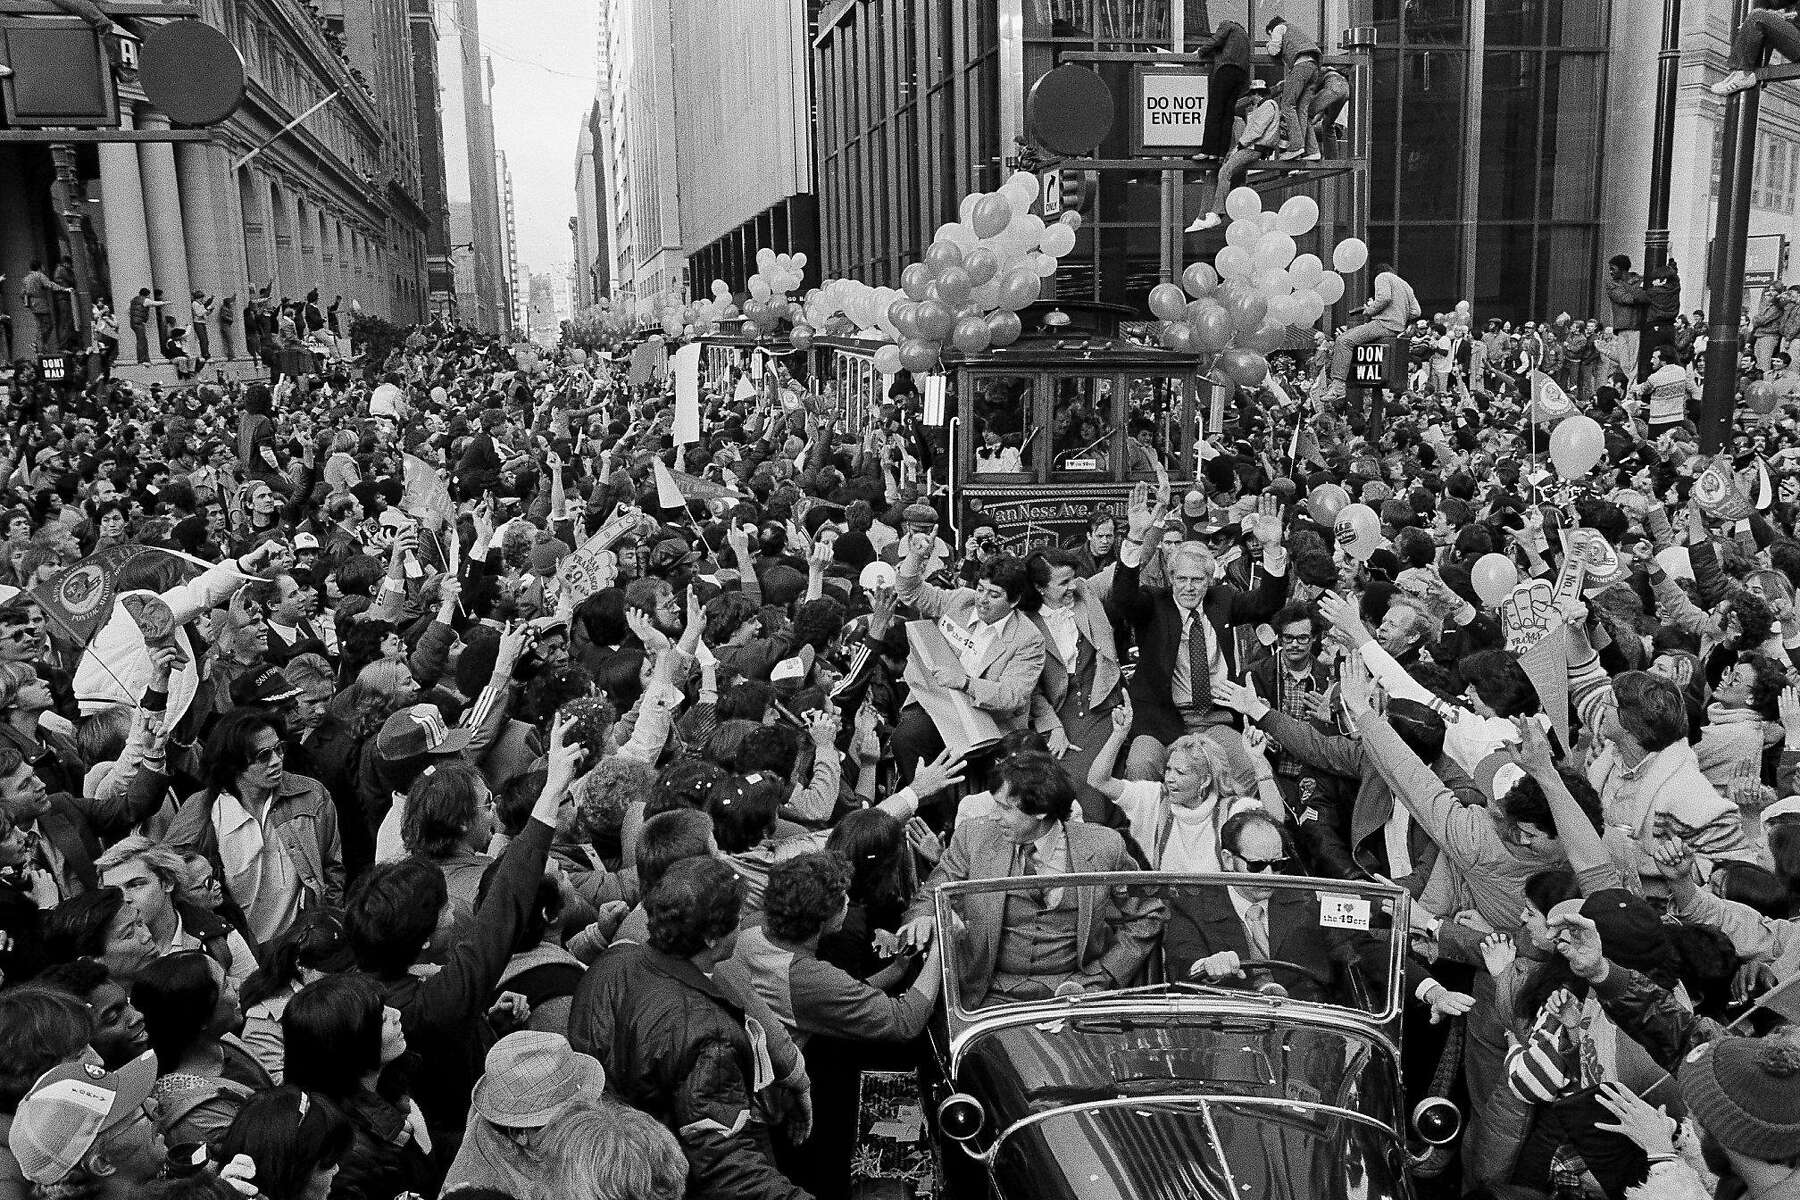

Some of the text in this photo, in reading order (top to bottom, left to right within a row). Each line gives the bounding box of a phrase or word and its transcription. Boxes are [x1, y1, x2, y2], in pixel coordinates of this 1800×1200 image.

[1147, 96, 1205, 109] DO NOT
[1151, 111, 1201, 124] ENTER
[1357, 346, 1383, 362] DON
[1356, 364, 1382, 380] WAL
[978, 506, 1018, 523] Van
[1018, 503, 1057, 520] Ness
[1337, 903, 1342, 912] I
[1339, 914, 1367, 925] 49ers
